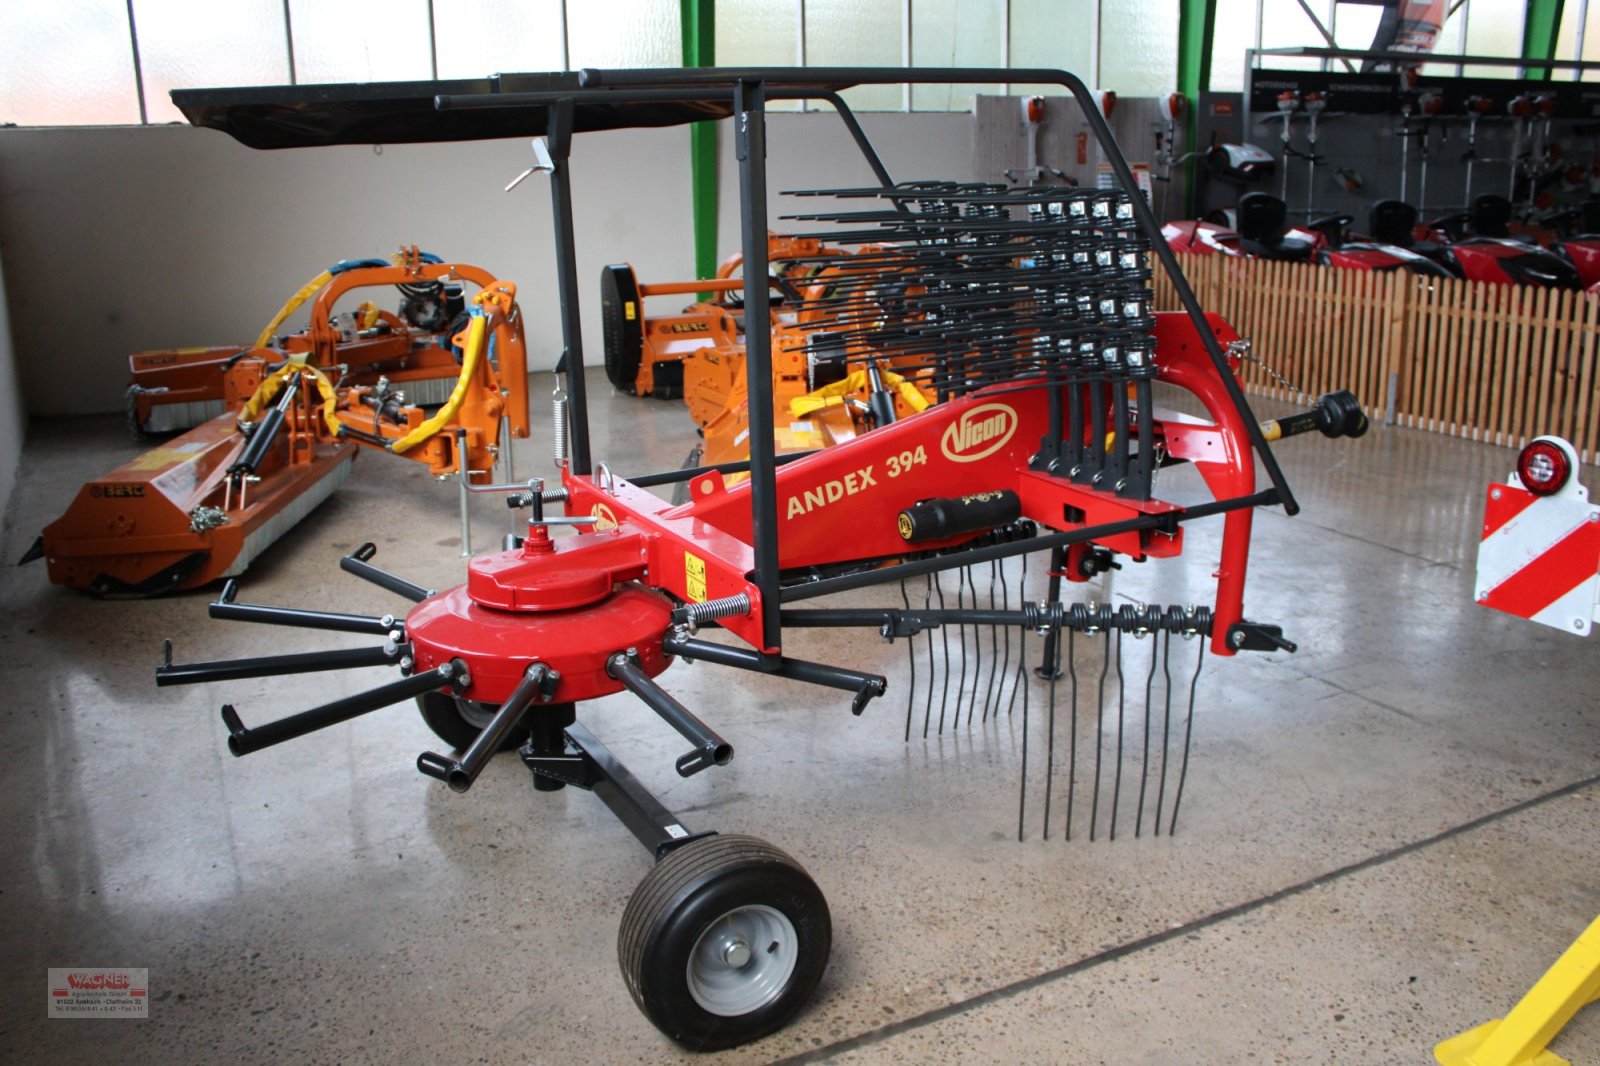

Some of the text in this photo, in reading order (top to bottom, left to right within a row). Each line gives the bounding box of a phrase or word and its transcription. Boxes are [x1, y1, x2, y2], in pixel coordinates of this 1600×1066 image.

[949, 408, 1009, 456] Vicon
[787, 445, 928, 520] ANDEX 394
